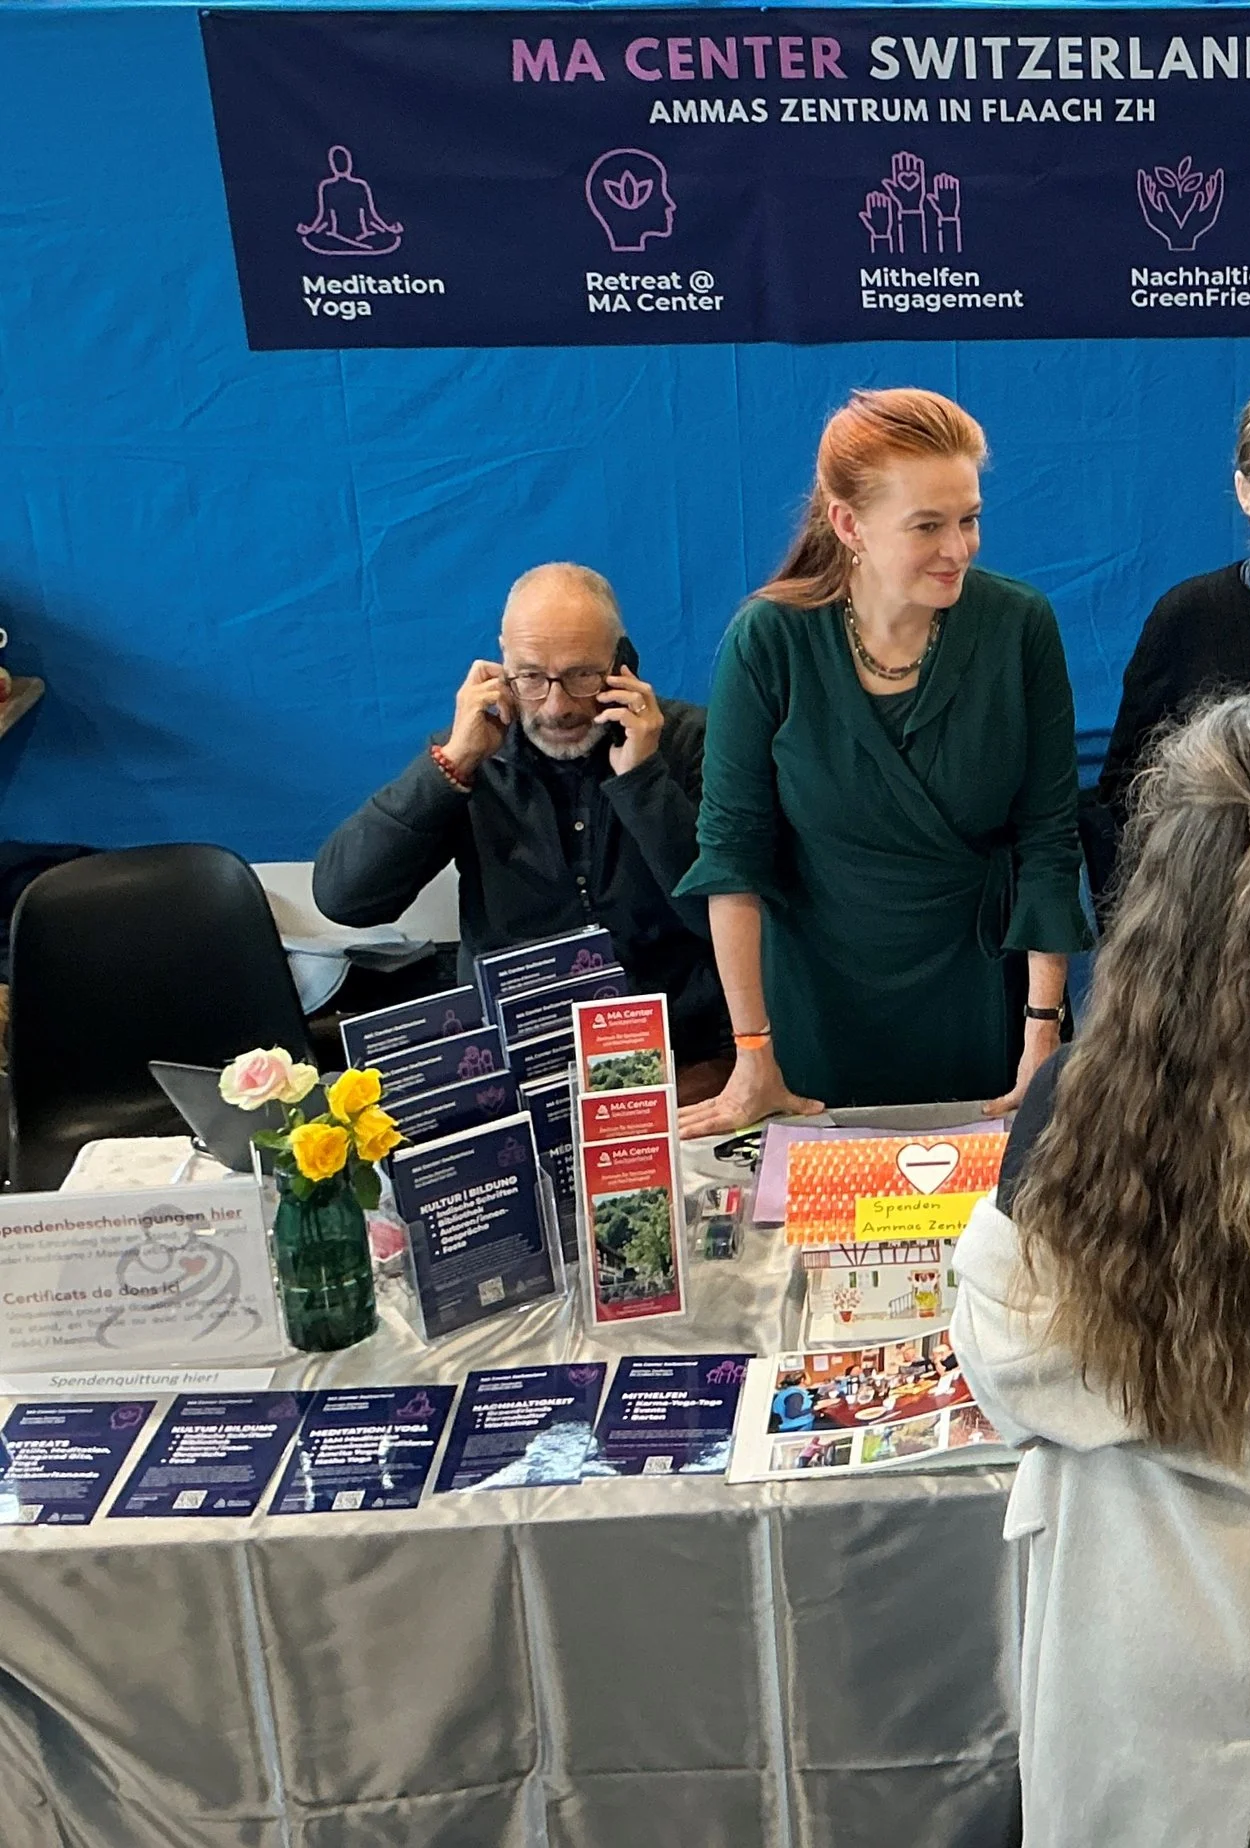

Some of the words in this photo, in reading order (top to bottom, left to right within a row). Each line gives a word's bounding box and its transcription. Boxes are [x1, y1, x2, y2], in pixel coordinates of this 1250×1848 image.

[511, 37, 606, 84] MA
[625, 36, 849, 82] CENTER
[649, 98, 768, 124] AMMAS
[780, 98, 930, 123] ZENTRUM
[939, 98, 971, 122] IN
[983, 98, 1102, 122] FLAACH
[1116, 97, 1156, 122] ZH
[303, 274, 445, 297] Meditation
[586, 271, 682, 292] Retreat
[689, 270, 715, 294] @
[860, 267, 980, 289] Mithelfen
[588, 293, 630, 314] MA
[637, 290, 724, 313] Center
[861, 286, 1024, 311] Engagement
[304, 297, 373, 321] Yoga
[607, 1011, 623, 1021] MA
[624, 1008, 654, 1019] Center
[610, 1103, 627, 1111] MA
[627, 1100, 658, 1110] Center
[612, 1149, 628, 1159] MA
[629, 1146, 660, 1157] Center
[420, 1193, 463, 1215] KULTUR
[468, 1175, 519, 1198] BILDUNG
[475, 1186, 519, 1206] Schriften
[211, 1207, 242, 1221] hier
[437, 1206, 485, 1228] Bibliothek
[874, 1200, 941, 1219] Spenden
[3, 1289, 88, 1305] Certificats
[92, 1285, 113, 1299] de
[119, 1284, 158, 1296] dons
[50, 1374, 180, 1388] Spendenquittung
[183, 1372, 219, 1384] hier!
[472, 1397, 575, 1412] NACHHALTIGKEIT
[621, 1391, 688, 1400] MITHELFEN
[171, 1425, 217, 1434] KULTUR
[224, 1424, 278, 1433] BILDUNG
[309, 1426, 386, 1438] MEDITATION
[394, 1424, 429, 1433] YOGA
[7, 1440, 70, 1449] RETREATS
